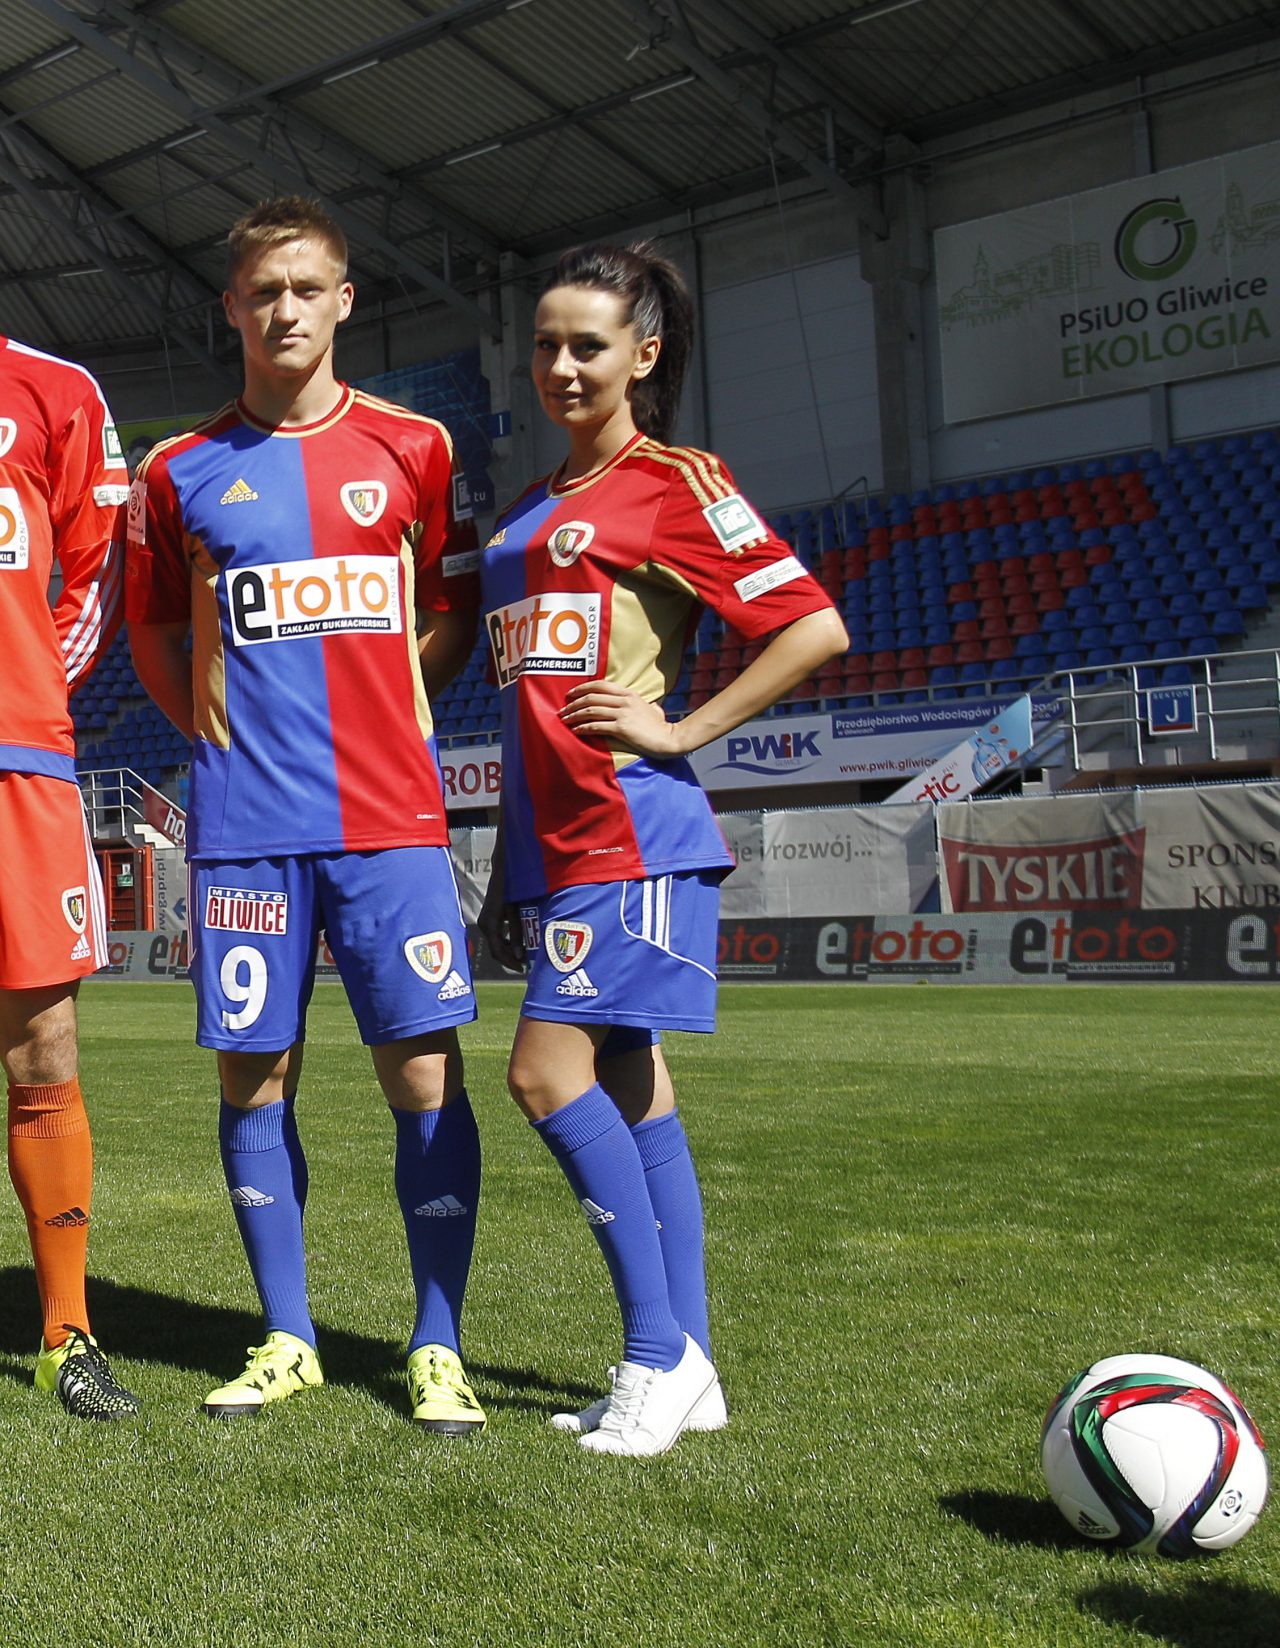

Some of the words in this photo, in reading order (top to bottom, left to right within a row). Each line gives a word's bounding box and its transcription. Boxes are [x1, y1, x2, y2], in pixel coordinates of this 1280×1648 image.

[1060, 298, 1148, 338] PSiUO
[1157, 277, 1268, 316] Gliwice
[1061, 306, 1271, 379] EKOLOGIA
[220, 490, 259, 506] adidas
[232, 560, 388, 641] etoto
[280, 622, 321, 636] ZAKŁADY
[322, 618, 389, 632] BUKMACHERSKIE
[489, 598, 588, 685] etoto
[588, 605, 597, 666] SPONSOR
[524, 660, 583, 669] MACHERSKIE
[1152, 689, 1190, 700] SEKTOR
[835, 713, 920, 730] Przedsiębiorstwo
[921, 705, 991, 723] Wodociągów
[1165, 699, 1179, 723] J
[727, 730, 823, 763] PWiK
[1168, 840, 1280, 869] SPONS
[956, 845, 1130, 904] TYSKIE
[212, 888, 285, 902] MIASTO
[207, 896, 286, 934] GLIWICE
[816, 920, 965, 976] etoto
[1009, 916, 1177, 974] etoto
[220, 944, 268, 1030] 9
[437, 984, 471, 1002] adidas
[555, 985, 599, 997] adidas
[414, 1205, 468, 1218] adidas
